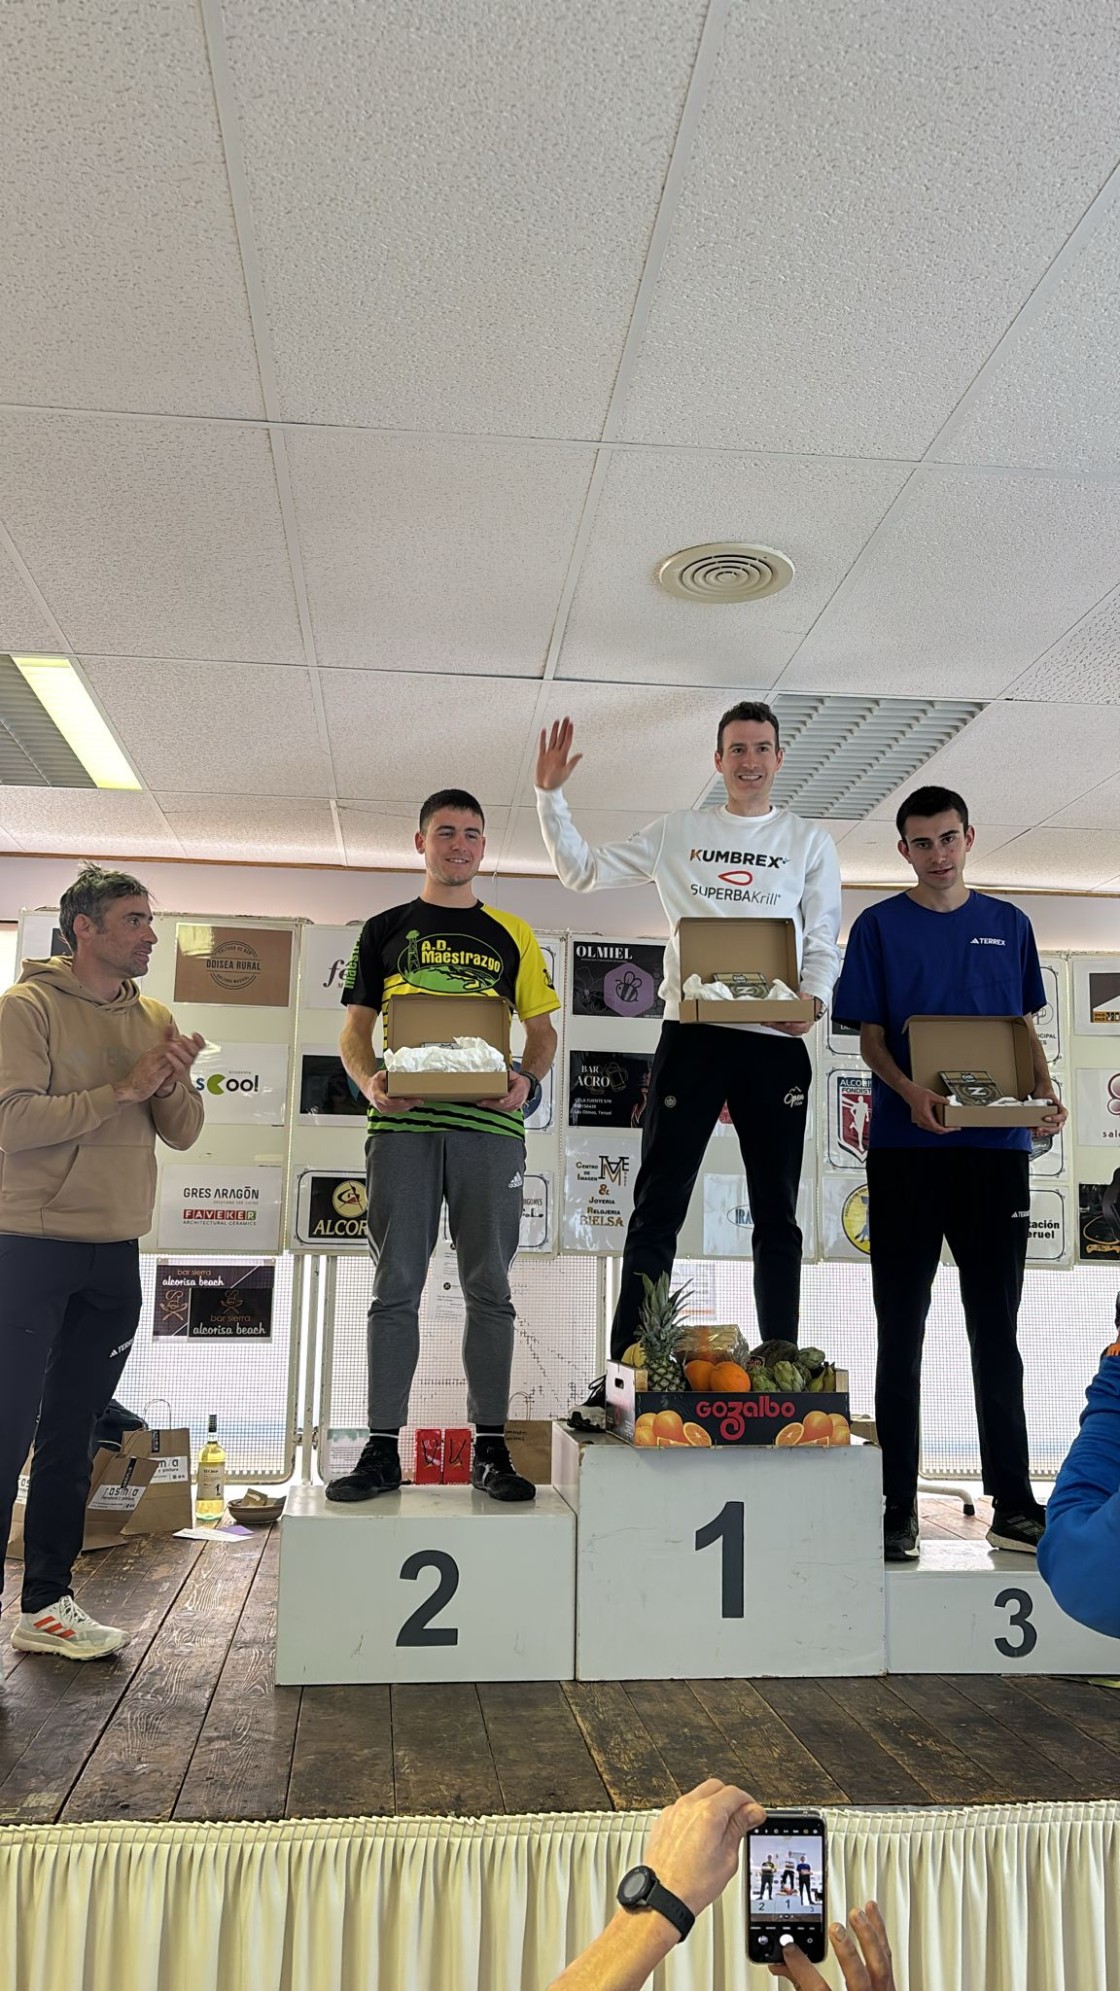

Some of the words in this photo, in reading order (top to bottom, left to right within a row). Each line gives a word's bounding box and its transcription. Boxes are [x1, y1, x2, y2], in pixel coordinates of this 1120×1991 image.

[689, 849, 781, 869] KUMBREX
[421, 940, 452, 951] A.D.
[980, 938, 1006, 947] TERREX
[576, 945, 633, 960] OLMIEL
[206, 959, 234, 969] ODISEA
[236, 960, 261, 971] RURAL
[421, 950, 501, 973] Maestrazgo
[581, 1065, 599, 1074] BAR
[577, 1075, 611, 1088] ACRO
[840, 1079, 872, 1087] ALCORI
[183, 1187, 212, 1199] GRES
[184, 1209, 256, 1220] FAVEKER
[735, 1208, 753, 1225] IRA
[312, 1219, 368, 1236] ALCOR
[579, 1215, 625, 1228] BIELSA
[1029, 1219, 1060, 1230] ación
[1028, 1230, 1055, 1239] eruel
[162, 1275, 196, 1287] alcorisa
[198, 1275, 225, 1286] beach
[210, 1314, 226, 1322] bar
[192, 1322, 234, 1335] alcorisa
[235, 1322, 267, 1335] beach
[694, 1500, 745, 1619] 1
[395, 1549, 460, 1647] 2
[993, 1587, 1038, 1658] 3
